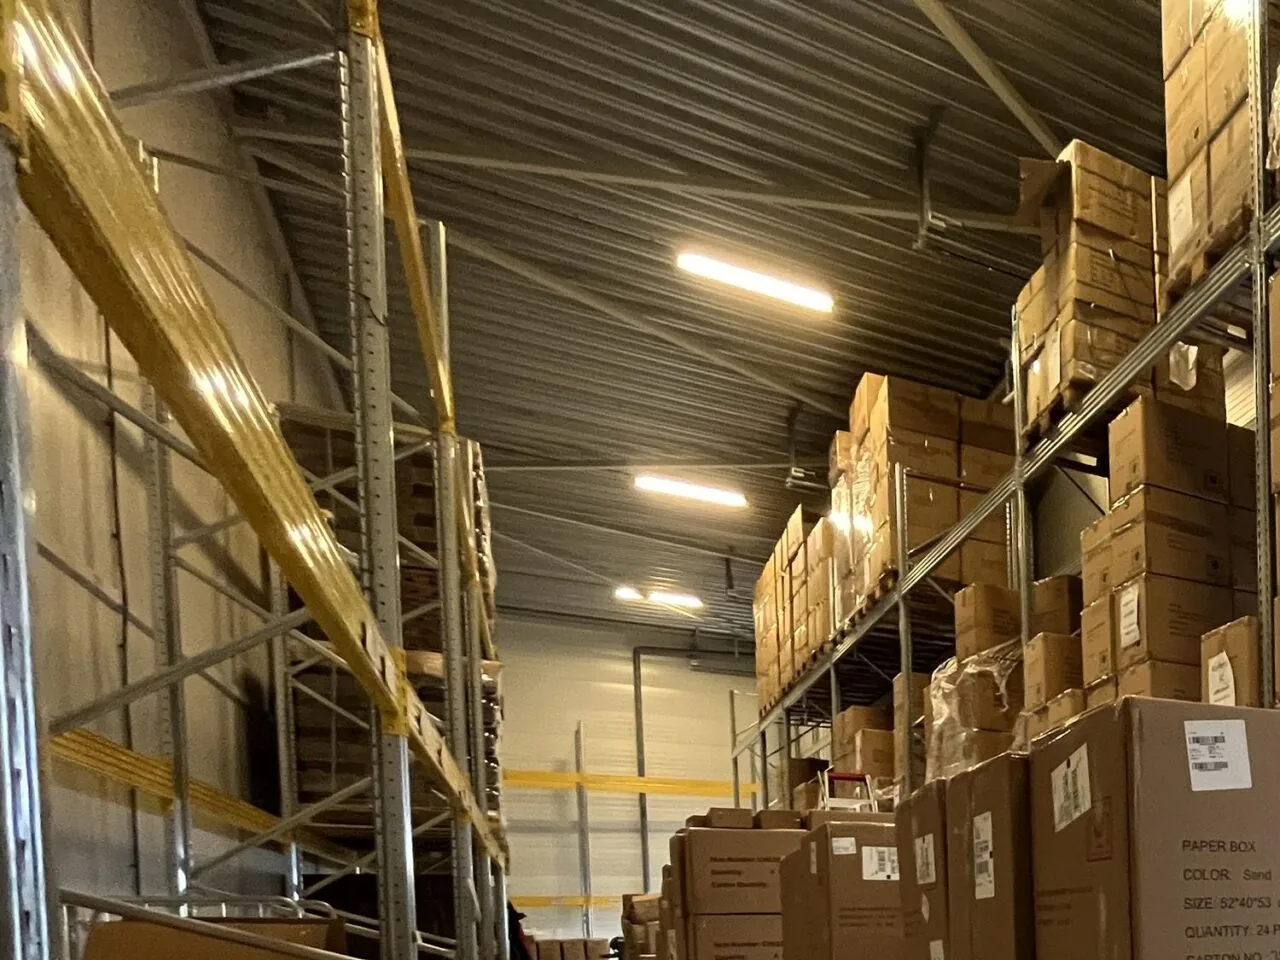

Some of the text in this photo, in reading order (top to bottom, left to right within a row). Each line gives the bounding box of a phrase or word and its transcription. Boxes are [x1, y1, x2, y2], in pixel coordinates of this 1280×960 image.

[1183, 839, 1256, 852] PAPER BOX
[1244, 869, 1272, 881] Sand
[1257, 925, 1270, 936] 24
